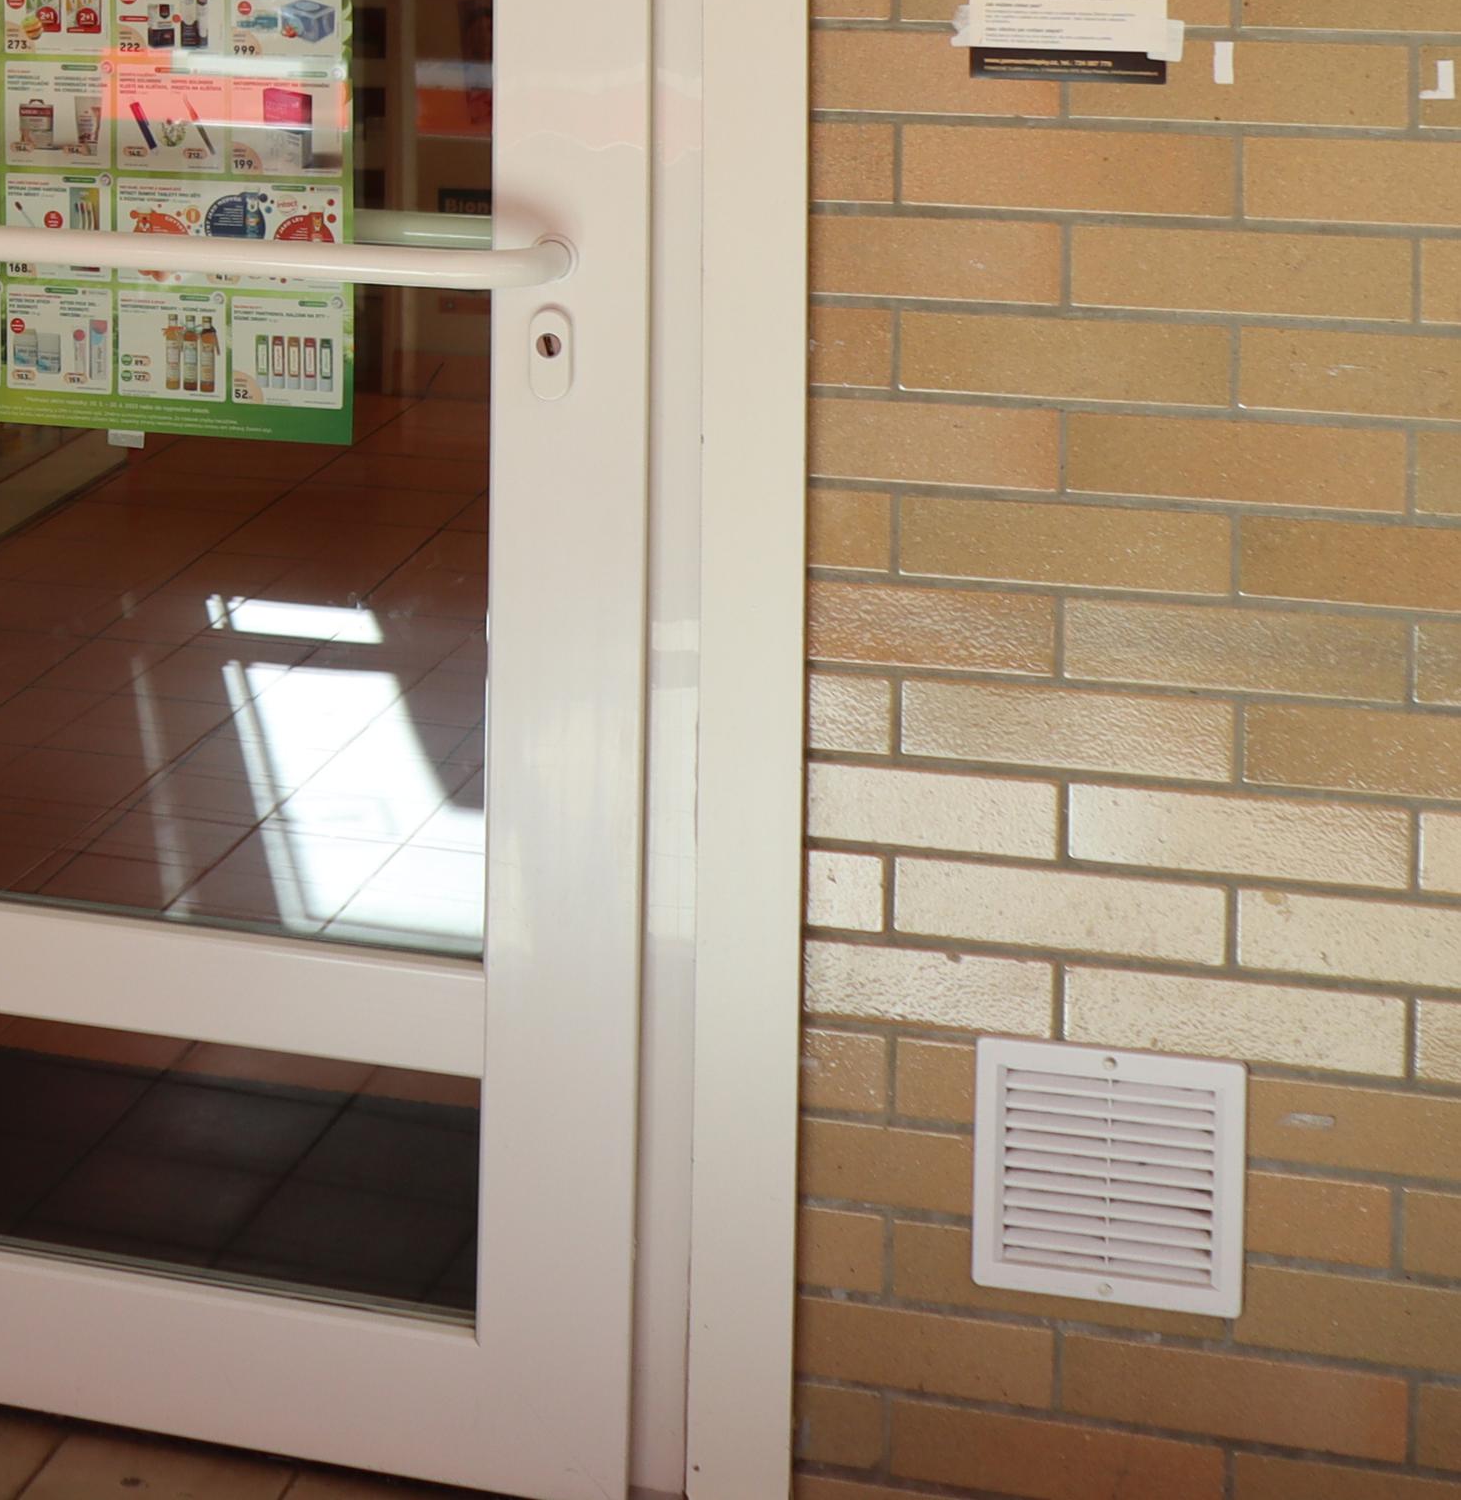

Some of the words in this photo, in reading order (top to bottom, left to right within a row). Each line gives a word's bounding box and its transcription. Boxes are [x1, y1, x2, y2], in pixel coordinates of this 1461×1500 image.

[7, 39, 27, 49] 273
[120, 42, 140, 52] 222
[233, 45, 255, 55] 999
[234, 159, 253, 169] 199
[9, 263, 28, 273] 168
[234, 389, 248, 399] 52
